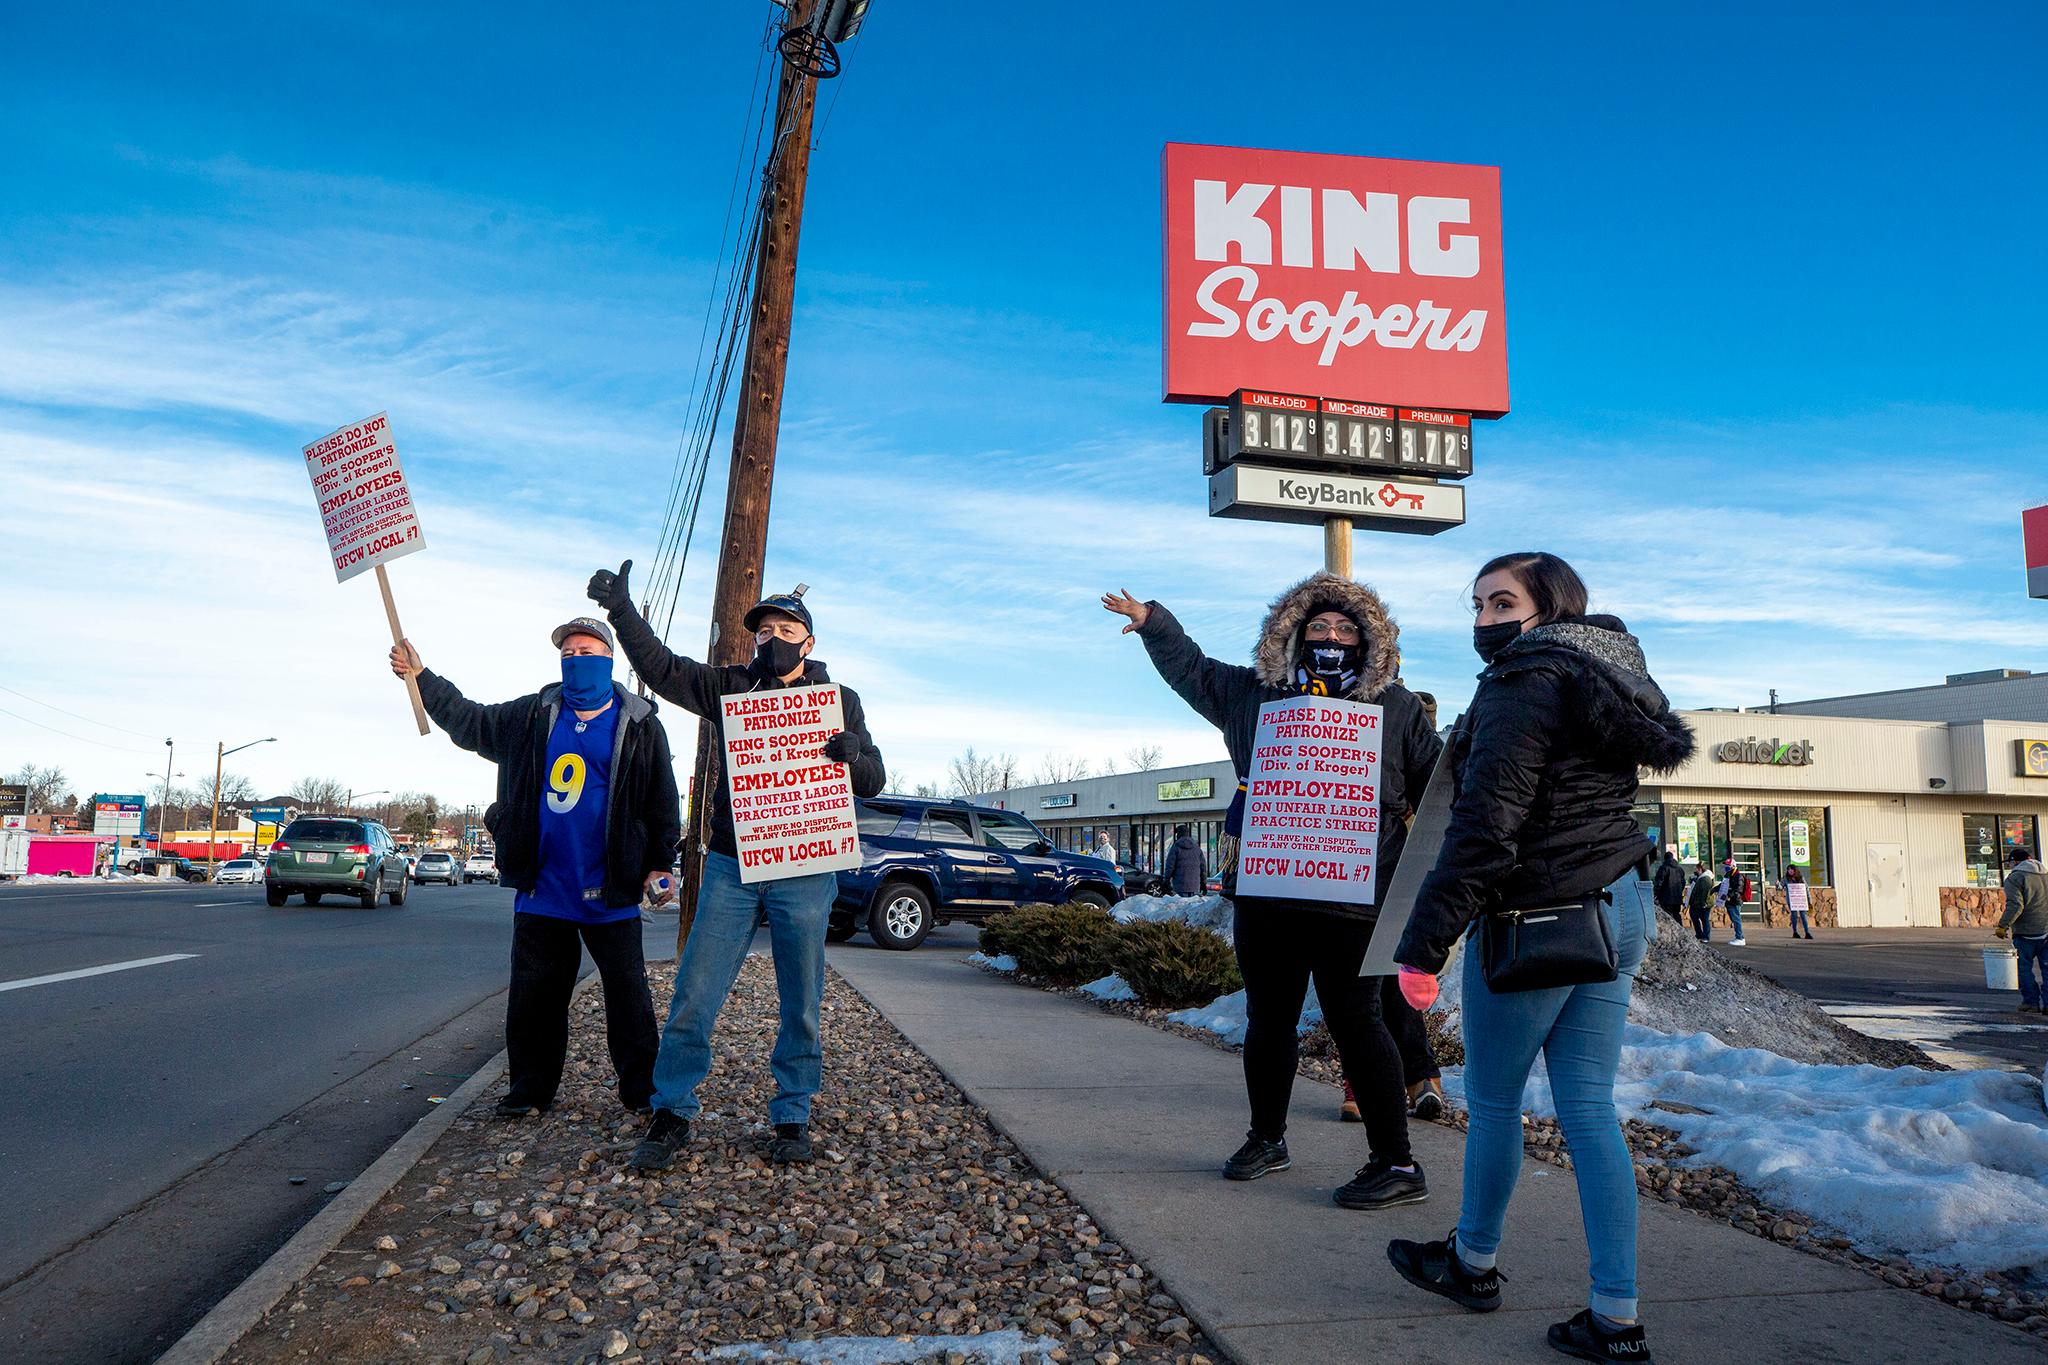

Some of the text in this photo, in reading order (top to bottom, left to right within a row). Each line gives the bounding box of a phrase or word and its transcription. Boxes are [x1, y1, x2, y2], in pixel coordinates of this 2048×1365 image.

[1194, 179, 1480, 278] KING
[1186, 265, 1488, 366] Soopers
[1253, 394, 1307, 409] UNLEADED
[1328, 402, 1388, 417] MID-GRADE
[1411, 411, 1454, 424] PREMIUM
[306, 418, 386, 461] PLEASE DO NOT
[321, 435, 377, 467] PATRONIZE
[314, 445, 394, 486] KING SOOPER'S
[320, 457, 393, 496] (Div. of Kroger)
[321, 471, 402, 515] EMPLOYEES
[1279, 479, 1376, 507] KeyBank
[325, 487, 407, 527] ON UNFAIR LABOR
[327, 497, 409, 537] PRACTICE STRIKE
[332, 514, 414, 551] WITH ANY OTHER EMPLOYER
[340, 534, 348, 542] WE
[350, 527, 364, 538] HAVE
[376, 512, 401, 525] DISPUTE
[336, 526, 418, 570] UFCW LOCAL #7
[725, 690, 836, 716] PLEASE DO NOT
[744, 710, 821, 731] PATRONIZE
[1262, 708, 1378, 728] PLEASE DO NOT
[728, 738, 764, 752] KING
[1275, 725, 1358, 742] PATRONIZE
[736, 754, 765, 768] (Div.
[770, 751, 782, 761] of
[1256, 745, 1376, 763] KING SOOPER'S
[1720, 736, 1814, 765] cricket
[732, 763, 846, 792] EMPLOYEES
[1260, 760, 1368, 777] (Div. of Kroger)
[547, 753, 586, 814] 9
[733, 783, 848, 809] ON UNFAIR LABOR
[1252, 781, 1374, 802] EMPLOYEES
[735, 797, 849, 822] PRACTICE STRIKE
[1251, 802, 1378, 818] ON UNFAIR LABOR
[740, 835, 761, 843] WITH
[782, 828, 808, 837] OTHER
[810, 822, 852, 833] EMPLOYER
[767, 823, 788, 832] HAVE
[790, 821, 802, 829] NO
[804, 816, 838, 827] DISPUTE
[1251, 816, 1376, 832] PRACTICE STRIKE
[742, 837, 854, 867] UFCW LOCAL #7
[1291, 843, 1320, 851] OTHER
[1323, 845, 1371, 855] EMPLOYER
[1318, 837, 1356, 846] DISPUTE
[1245, 857, 1370, 882] UFCW LOCAL #7
